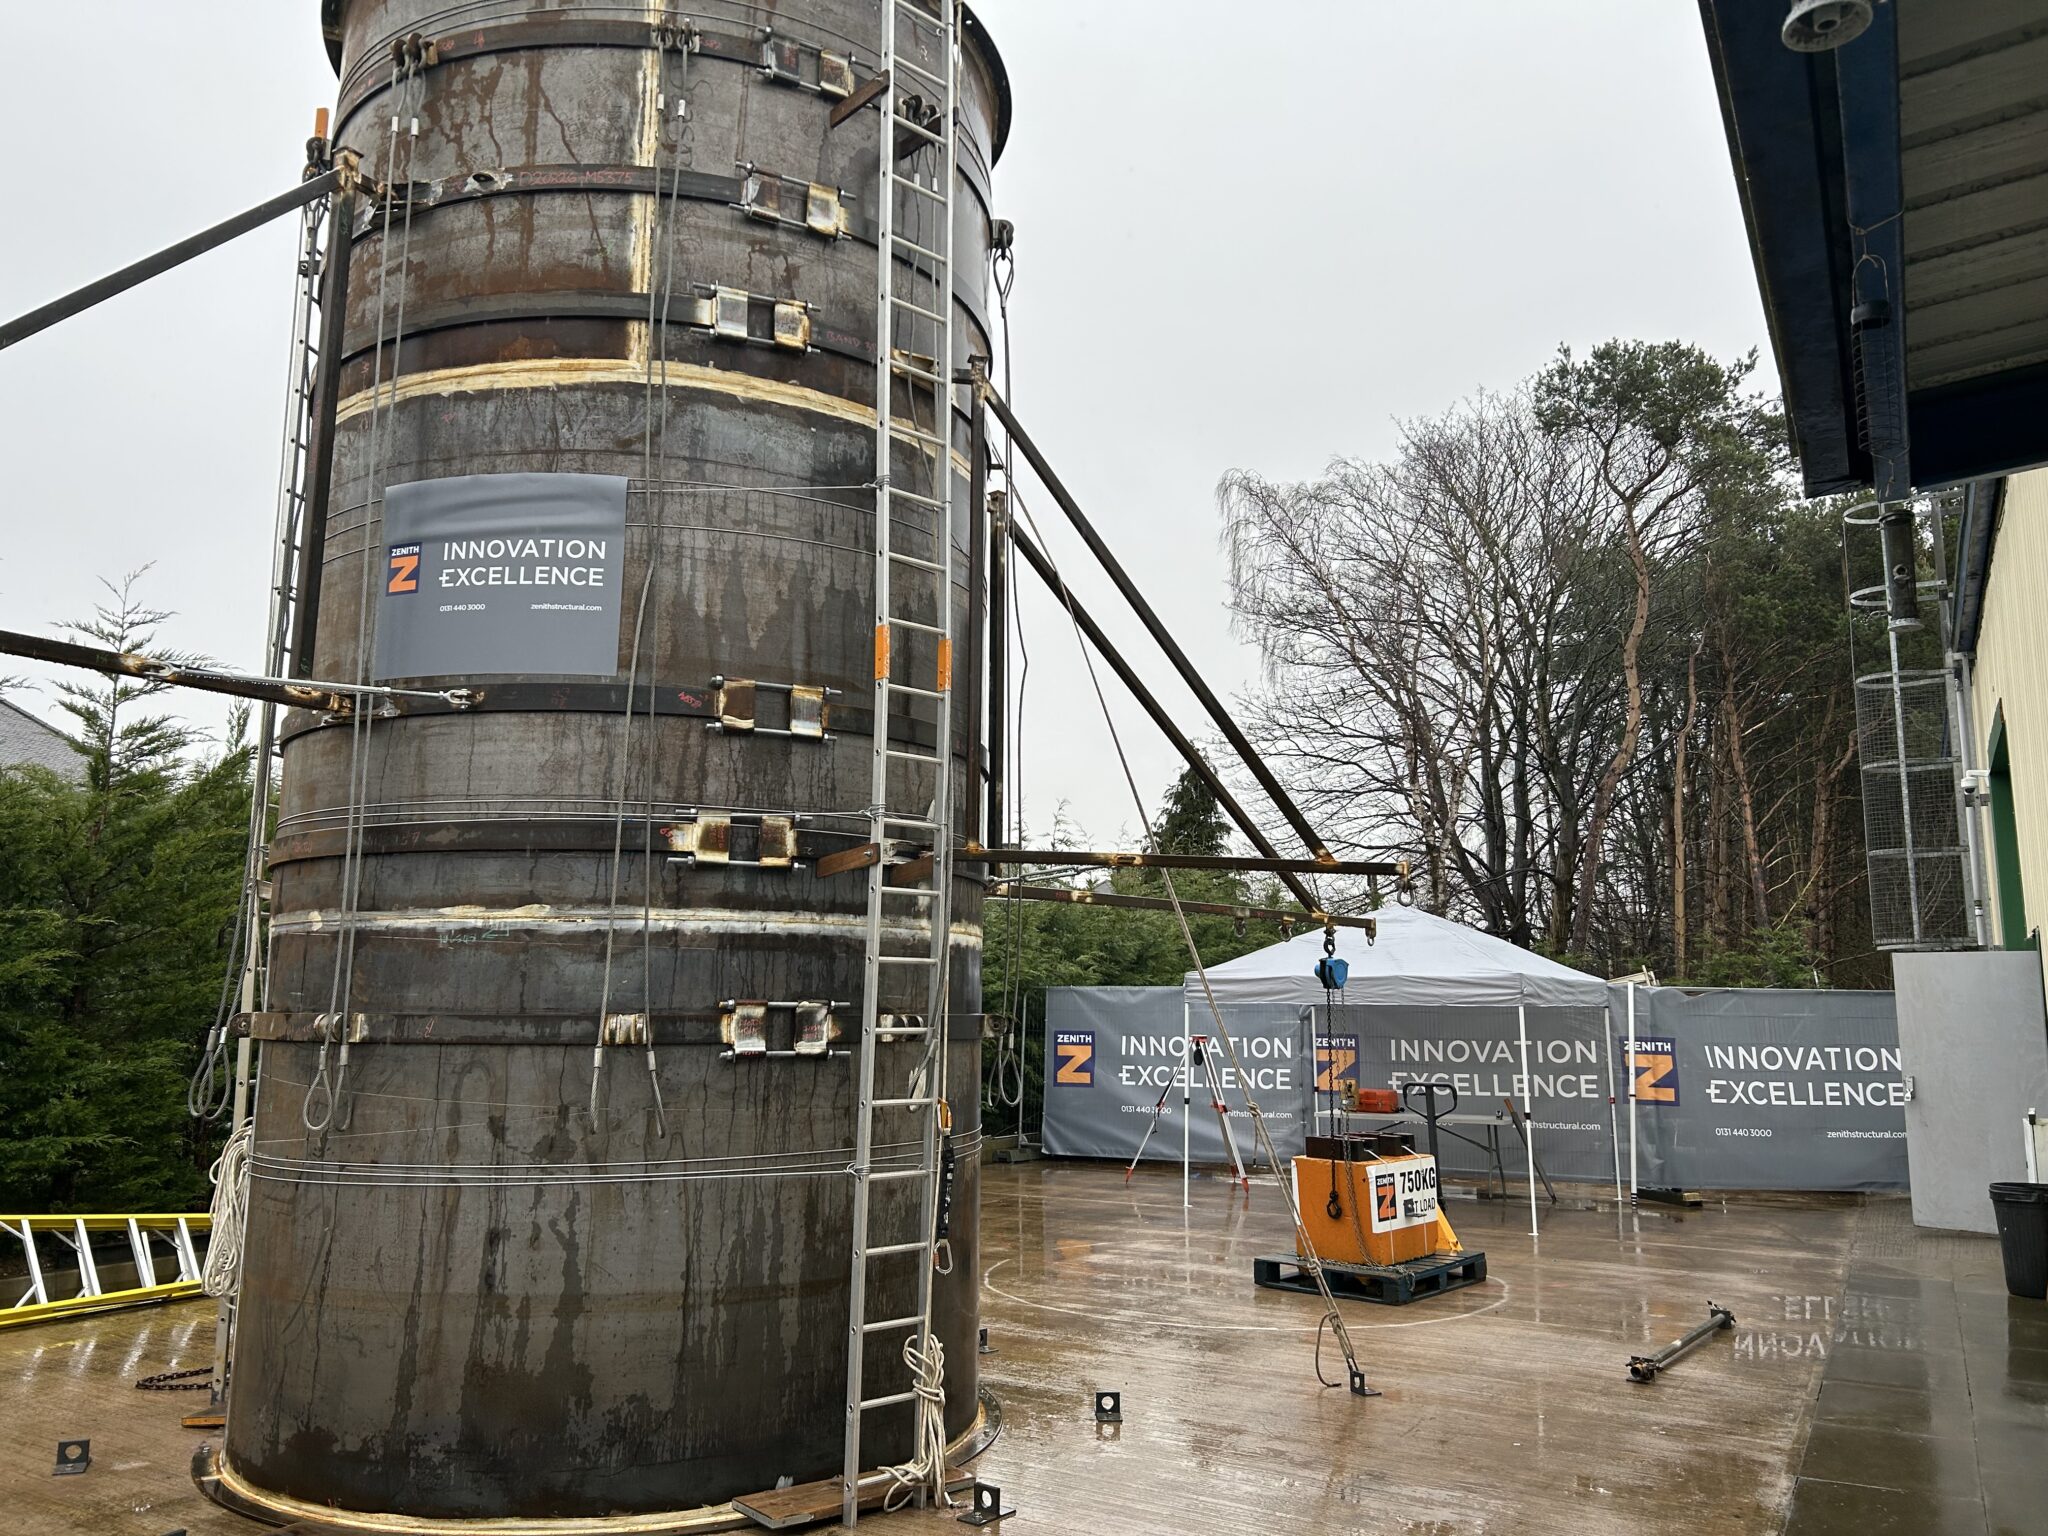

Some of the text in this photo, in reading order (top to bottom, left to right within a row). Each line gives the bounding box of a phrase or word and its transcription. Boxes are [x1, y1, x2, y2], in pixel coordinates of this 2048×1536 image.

[391, 545, 420, 557] ZENITH
[443, 539, 606, 561] INNOVATION
[439, 566, 604, 588] EXCELLENCE
[467, 603, 486, 611] 3000
[530, 603, 602, 611] zenithstructural.com
[1057, 1034, 1092, 1043] ZENITH
[1315, 1038, 1356, 1047] ZENITH
[1704, 1046, 1902, 1071] INNOVATION
[1706, 1080, 1905, 1106] EXCELLENCE
[1121, 1105, 1135, 1113] 0131
[1136, 1106, 1151, 1114] 440
[1715, 1128, 1772, 1137] 0131 440 3000
[1400, 1167, 1436, 1194] 750KG
[1419, 1197, 1436, 1212] LOAD
